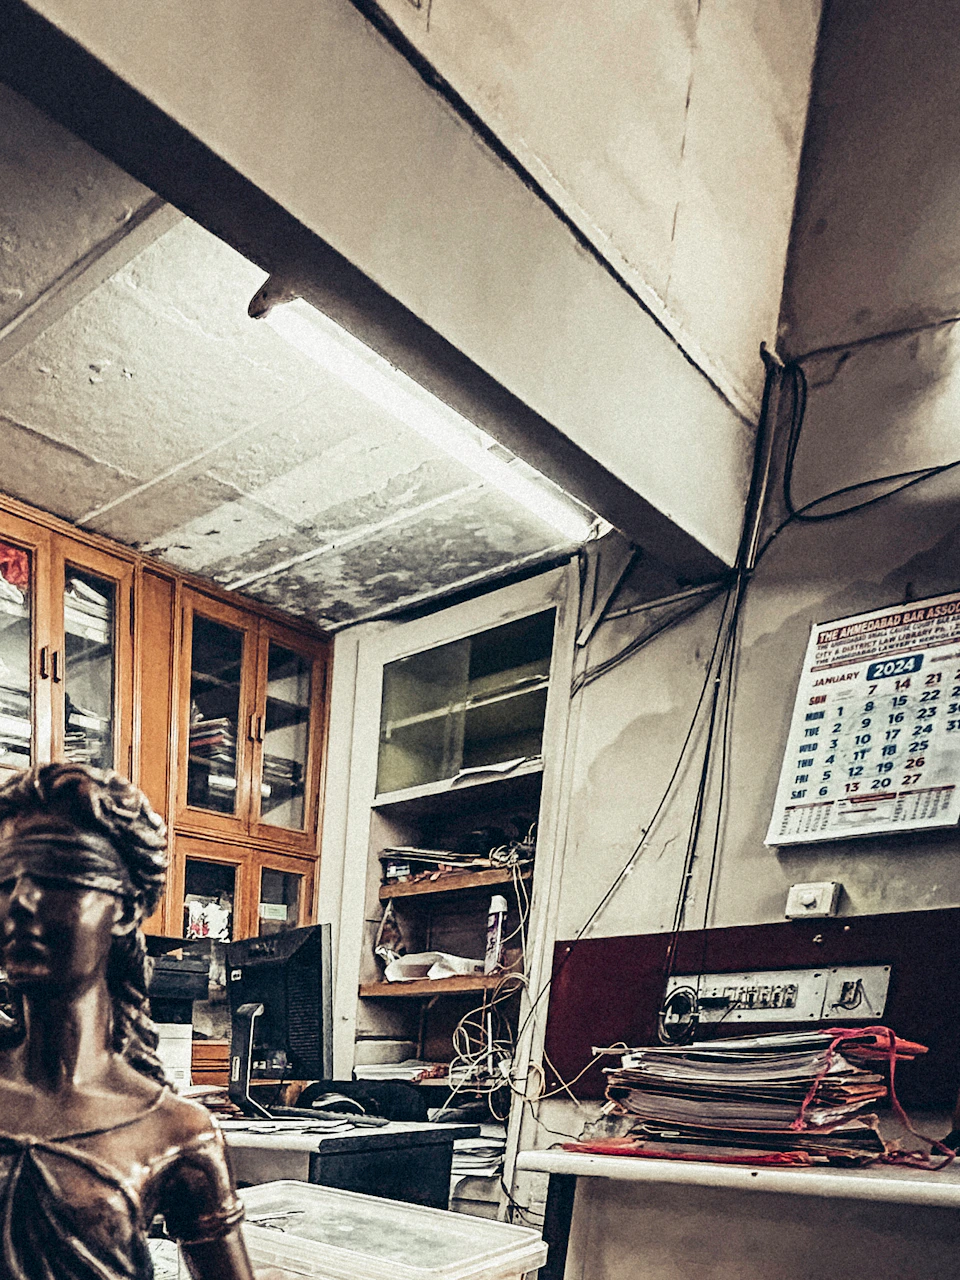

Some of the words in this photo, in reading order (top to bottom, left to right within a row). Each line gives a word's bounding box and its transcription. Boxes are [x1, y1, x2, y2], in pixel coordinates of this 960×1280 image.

[820, 632, 839, 643] THE
[840, 615, 901, 640] AHMEDABAD
[903, 610, 925, 622] BAR
[815, 650, 832, 659] CITY
[842, 640, 877, 654] DISTRICT
[878, 636, 897, 646] LAW
[812, 671, 860, 687] JANUARY
[874, 658, 915, 678] 2024
[809, 695, 827, 705] SUN
[869, 685, 878, 695] 7
[894, 678, 911, 690] 14
[925, 673, 942, 685] 21
[805, 710, 826, 721] MON
[837, 706, 844, 717] 1
[864, 701, 874, 711] 8
[892, 695, 908, 707] 15
[919, 689, 941, 703] 22
[804, 726, 820, 737] TUE
[832, 723, 842, 733] 2
[861, 718, 872, 728] 9
[889, 712, 905, 723] 16
[916, 707, 937, 719] 23
[799, 743, 818, 753] WED
[829, 739, 838, 749] 3
[855, 734, 871, 745] 10
[885, 729, 901, 740] 17
[912, 724, 933, 736] 24
[797, 758, 814, 768] THU
[825, 755, 835, 765] 4
[853, 750, 867, 761] 11
[882, 745, 897, 756] 18
[908, 740, 929, 752] 25
[795, 774, 809, 784] FRI
[822, 770, 831, 780] 5
[848, 766, 864, 777] 12
[876, 762, 893, 773] 19
[904, 757, 925, 769] 26
[791, 789, 807, 800] SAT
[818, 787, 828, 796] 6
[844, 782, 860, 793] 13
[870, 778, 891, 789] 20
[901, 773, 922, 786] 27
